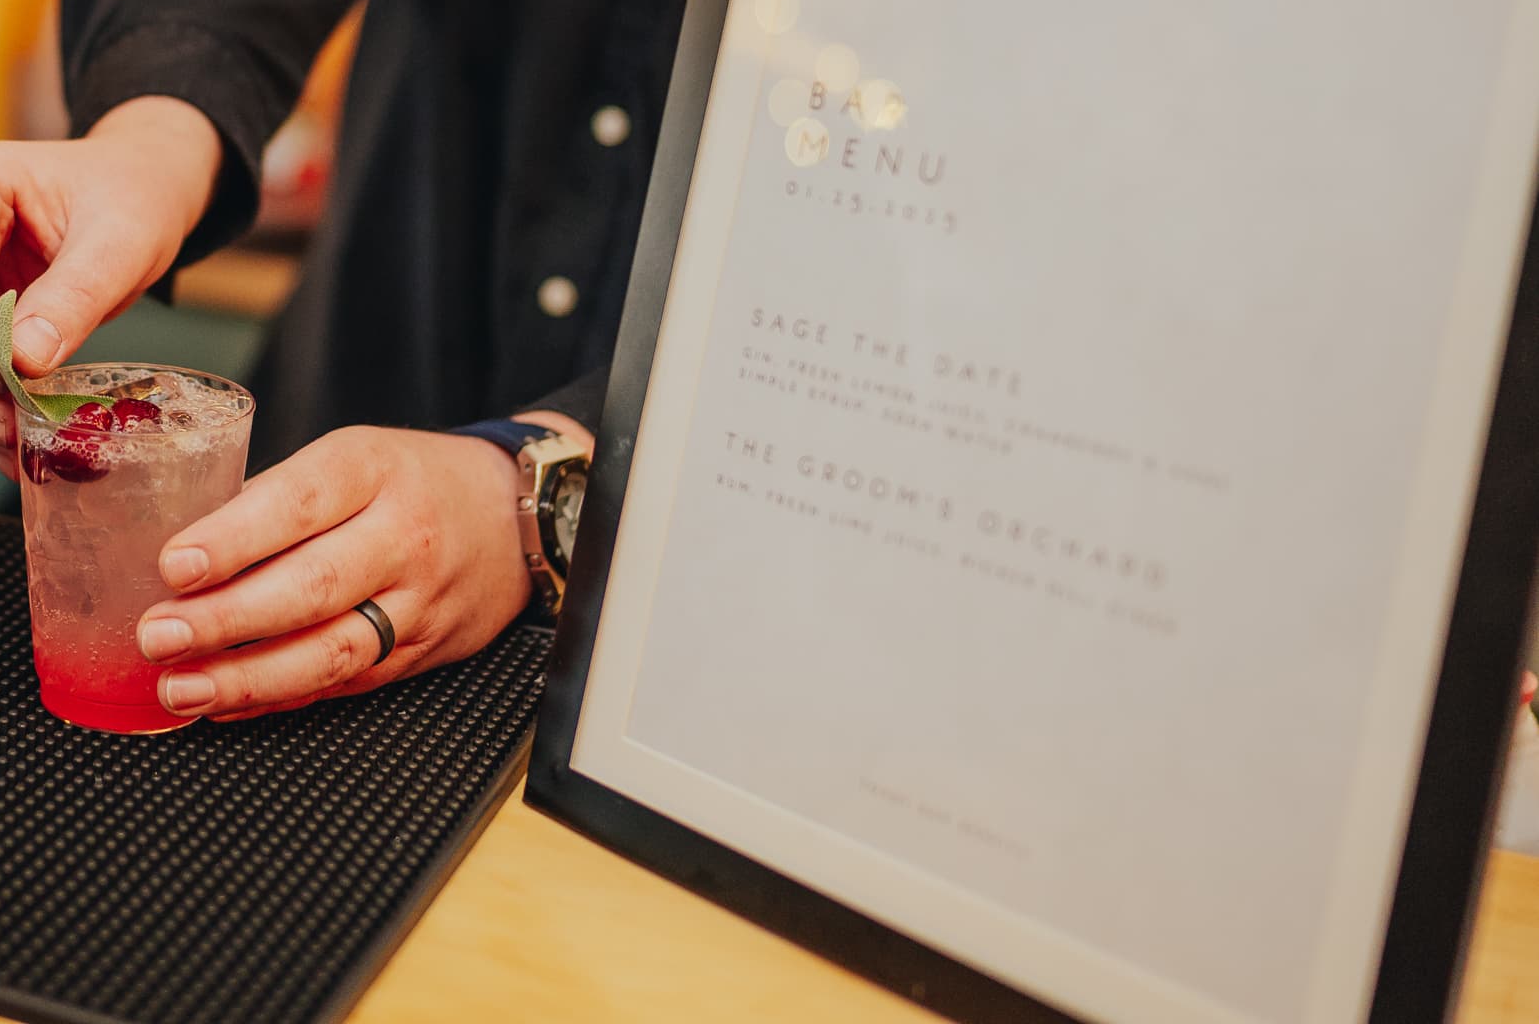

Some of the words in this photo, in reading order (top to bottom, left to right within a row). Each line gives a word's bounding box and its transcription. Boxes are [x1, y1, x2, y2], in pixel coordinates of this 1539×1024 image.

[798, 129, 947, 185] MENU
[751, 308, 829, 345] SAGE
[852, 332, 909, 367] THE
[933, 353, 1022, 397] DATE
[725, 430, 775, 465] THE
[796, 454, 952, 522] GROOM'S
[976, 509, 1169, 592] ORCHARD
